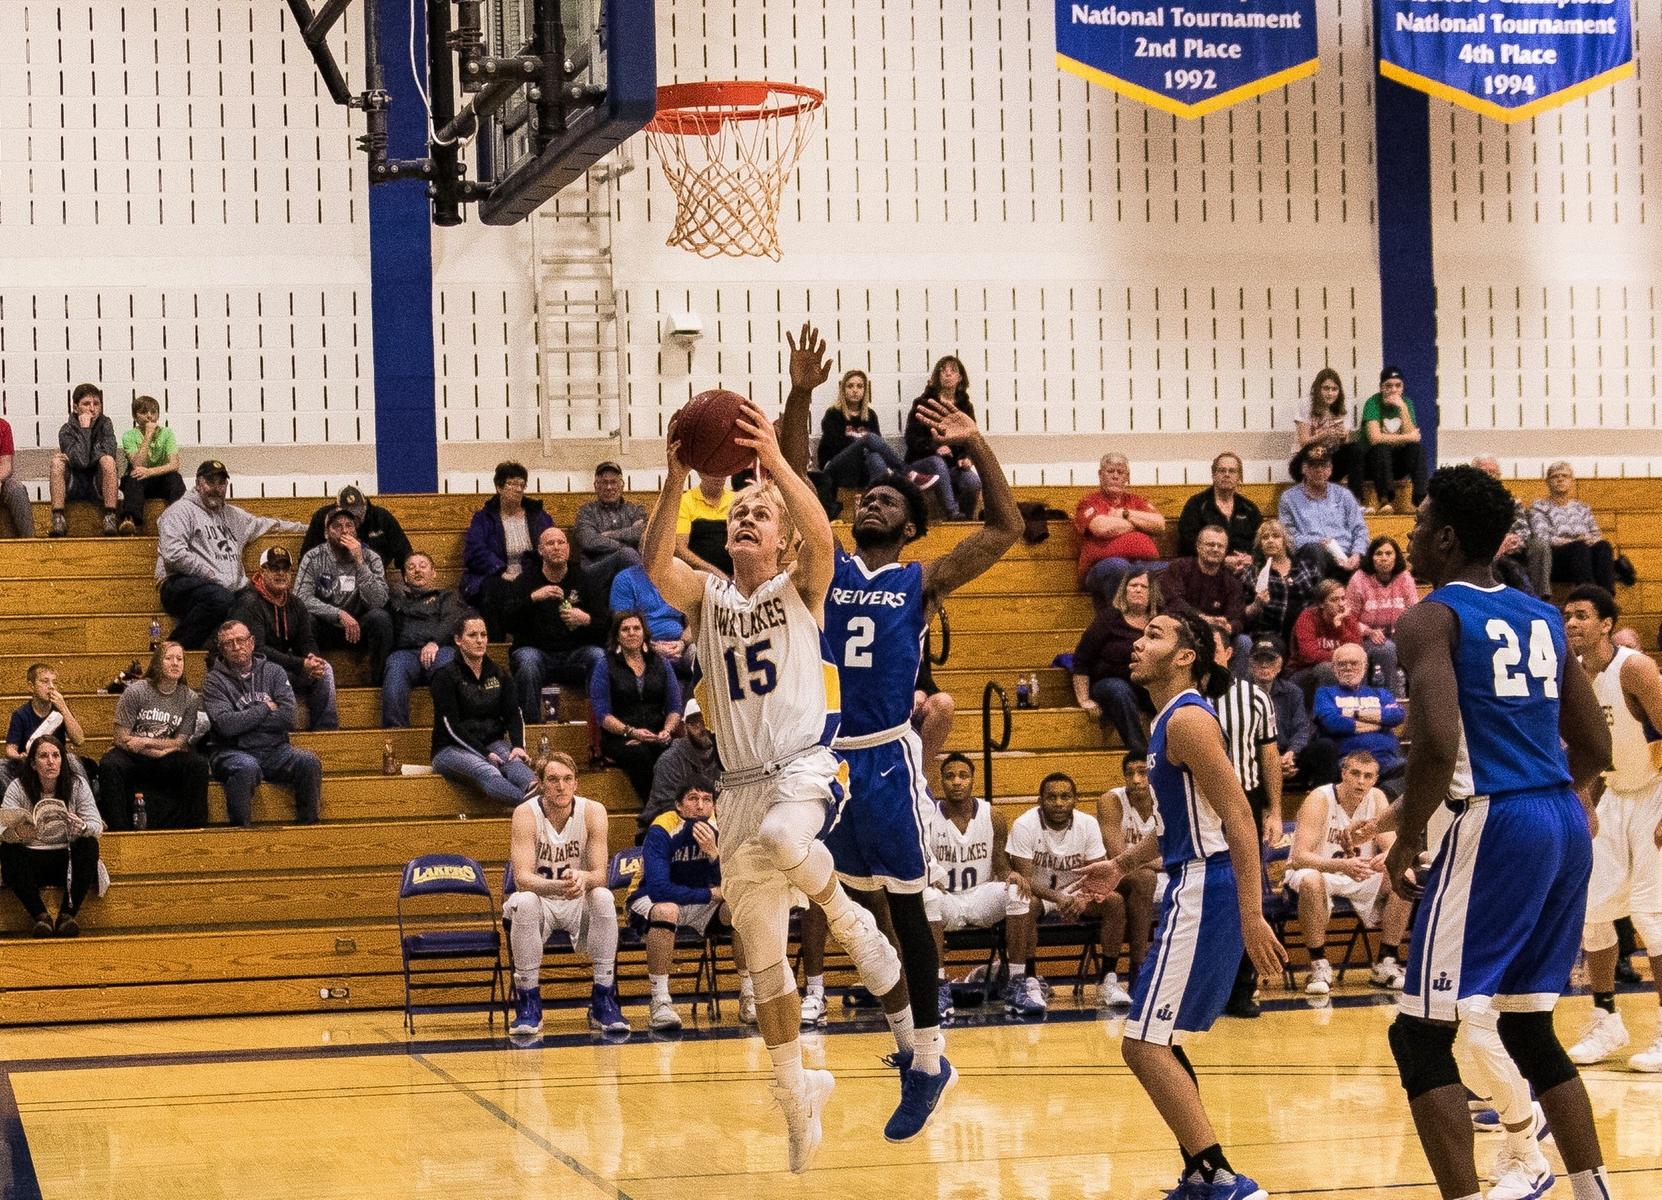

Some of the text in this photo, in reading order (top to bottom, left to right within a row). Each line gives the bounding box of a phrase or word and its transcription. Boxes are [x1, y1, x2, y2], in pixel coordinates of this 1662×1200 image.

[1072, 4, 1301, 29] National Tournament
[1396, 12, 1617, 35] National Tournament
[1135, 37, 1242, 59] 2nd Place
[1458, 43, 1558, 65] 4th Place
[1164, 69, 1217, 90] 1992
[1484, 74, 1536, 95] 1994
[831, 587, 906, 608] REIVERS
[738, 597, 787, 639] LAKES
[844, 616, 875, 668] 2
[1485, 619, 1559, 698] 24
[724, 639, 778, 701] 15
[961, 842, 988, 863] LAKES
[412, 865, 477, 884] LAKERS
[947, 866, 977, 892] 10
